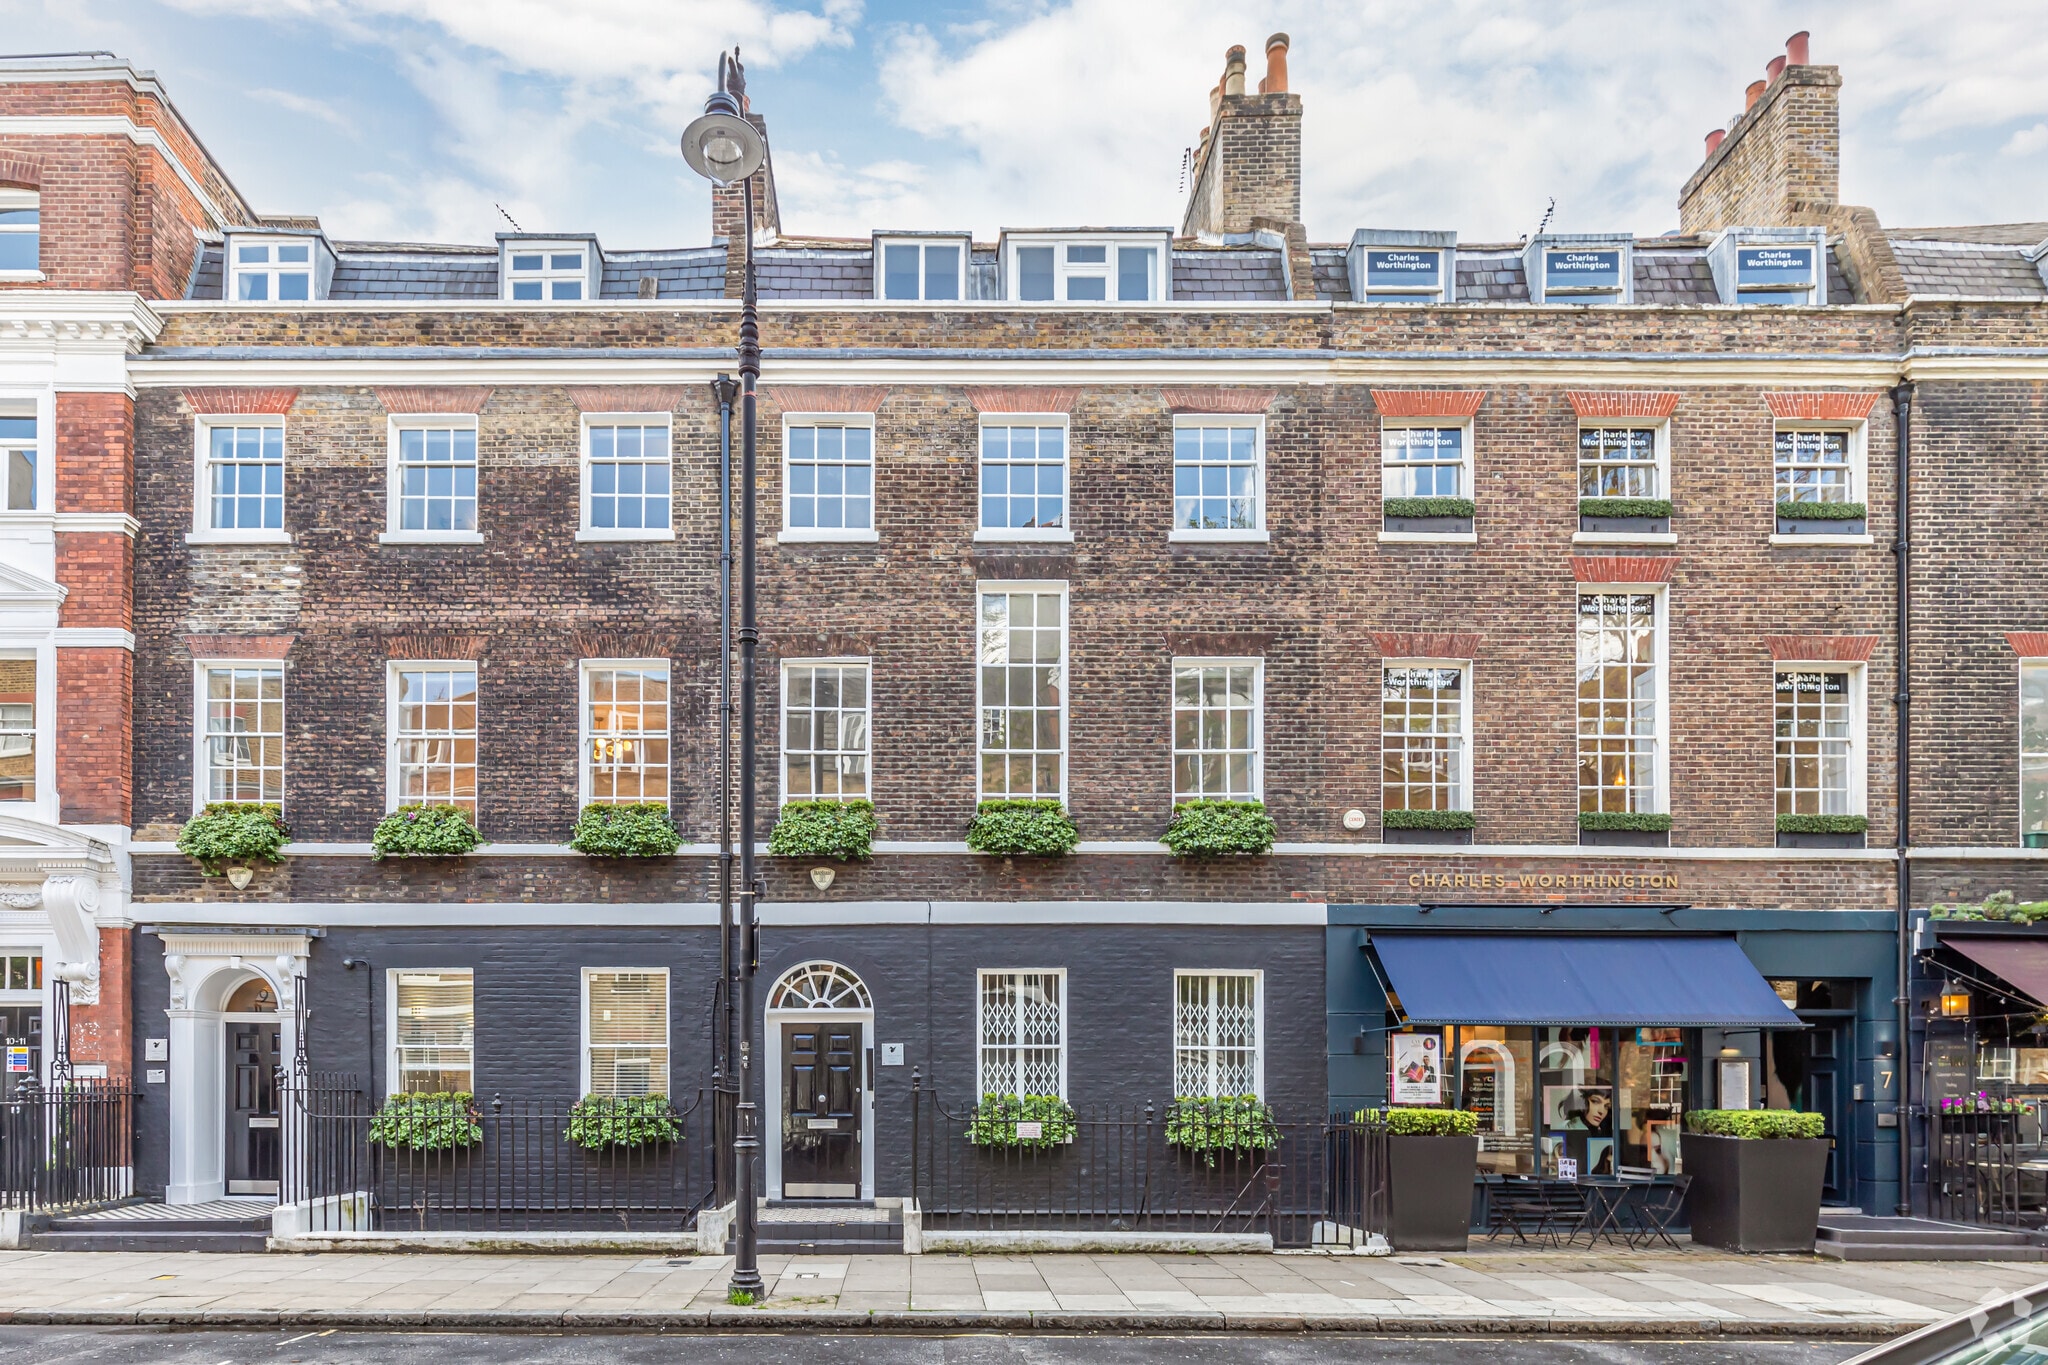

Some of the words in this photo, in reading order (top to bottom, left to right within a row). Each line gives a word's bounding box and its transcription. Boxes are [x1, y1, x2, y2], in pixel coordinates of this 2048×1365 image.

[1376, 261, 1431, 270] Worthington
[1555, 262, 1610, 270] Worthington
[1747, 259, 1803, 268] Worthington
[1400, 430, 1442, 438] Charles
[1388, 438, 1453, 447] Worthington
[1582, 439, 1646, 447] Worthington
[1775, 442, 1840, 450] Worthington
[1408, 874, 1505, 887] CHARLES
[1519, 874, 1679, 888] WORTHINGTON
[259, 989, 269, 1002] 9
[5, 1037, 26, 1045] 10-11
[1880, 1071, 1892, 1089] 7
